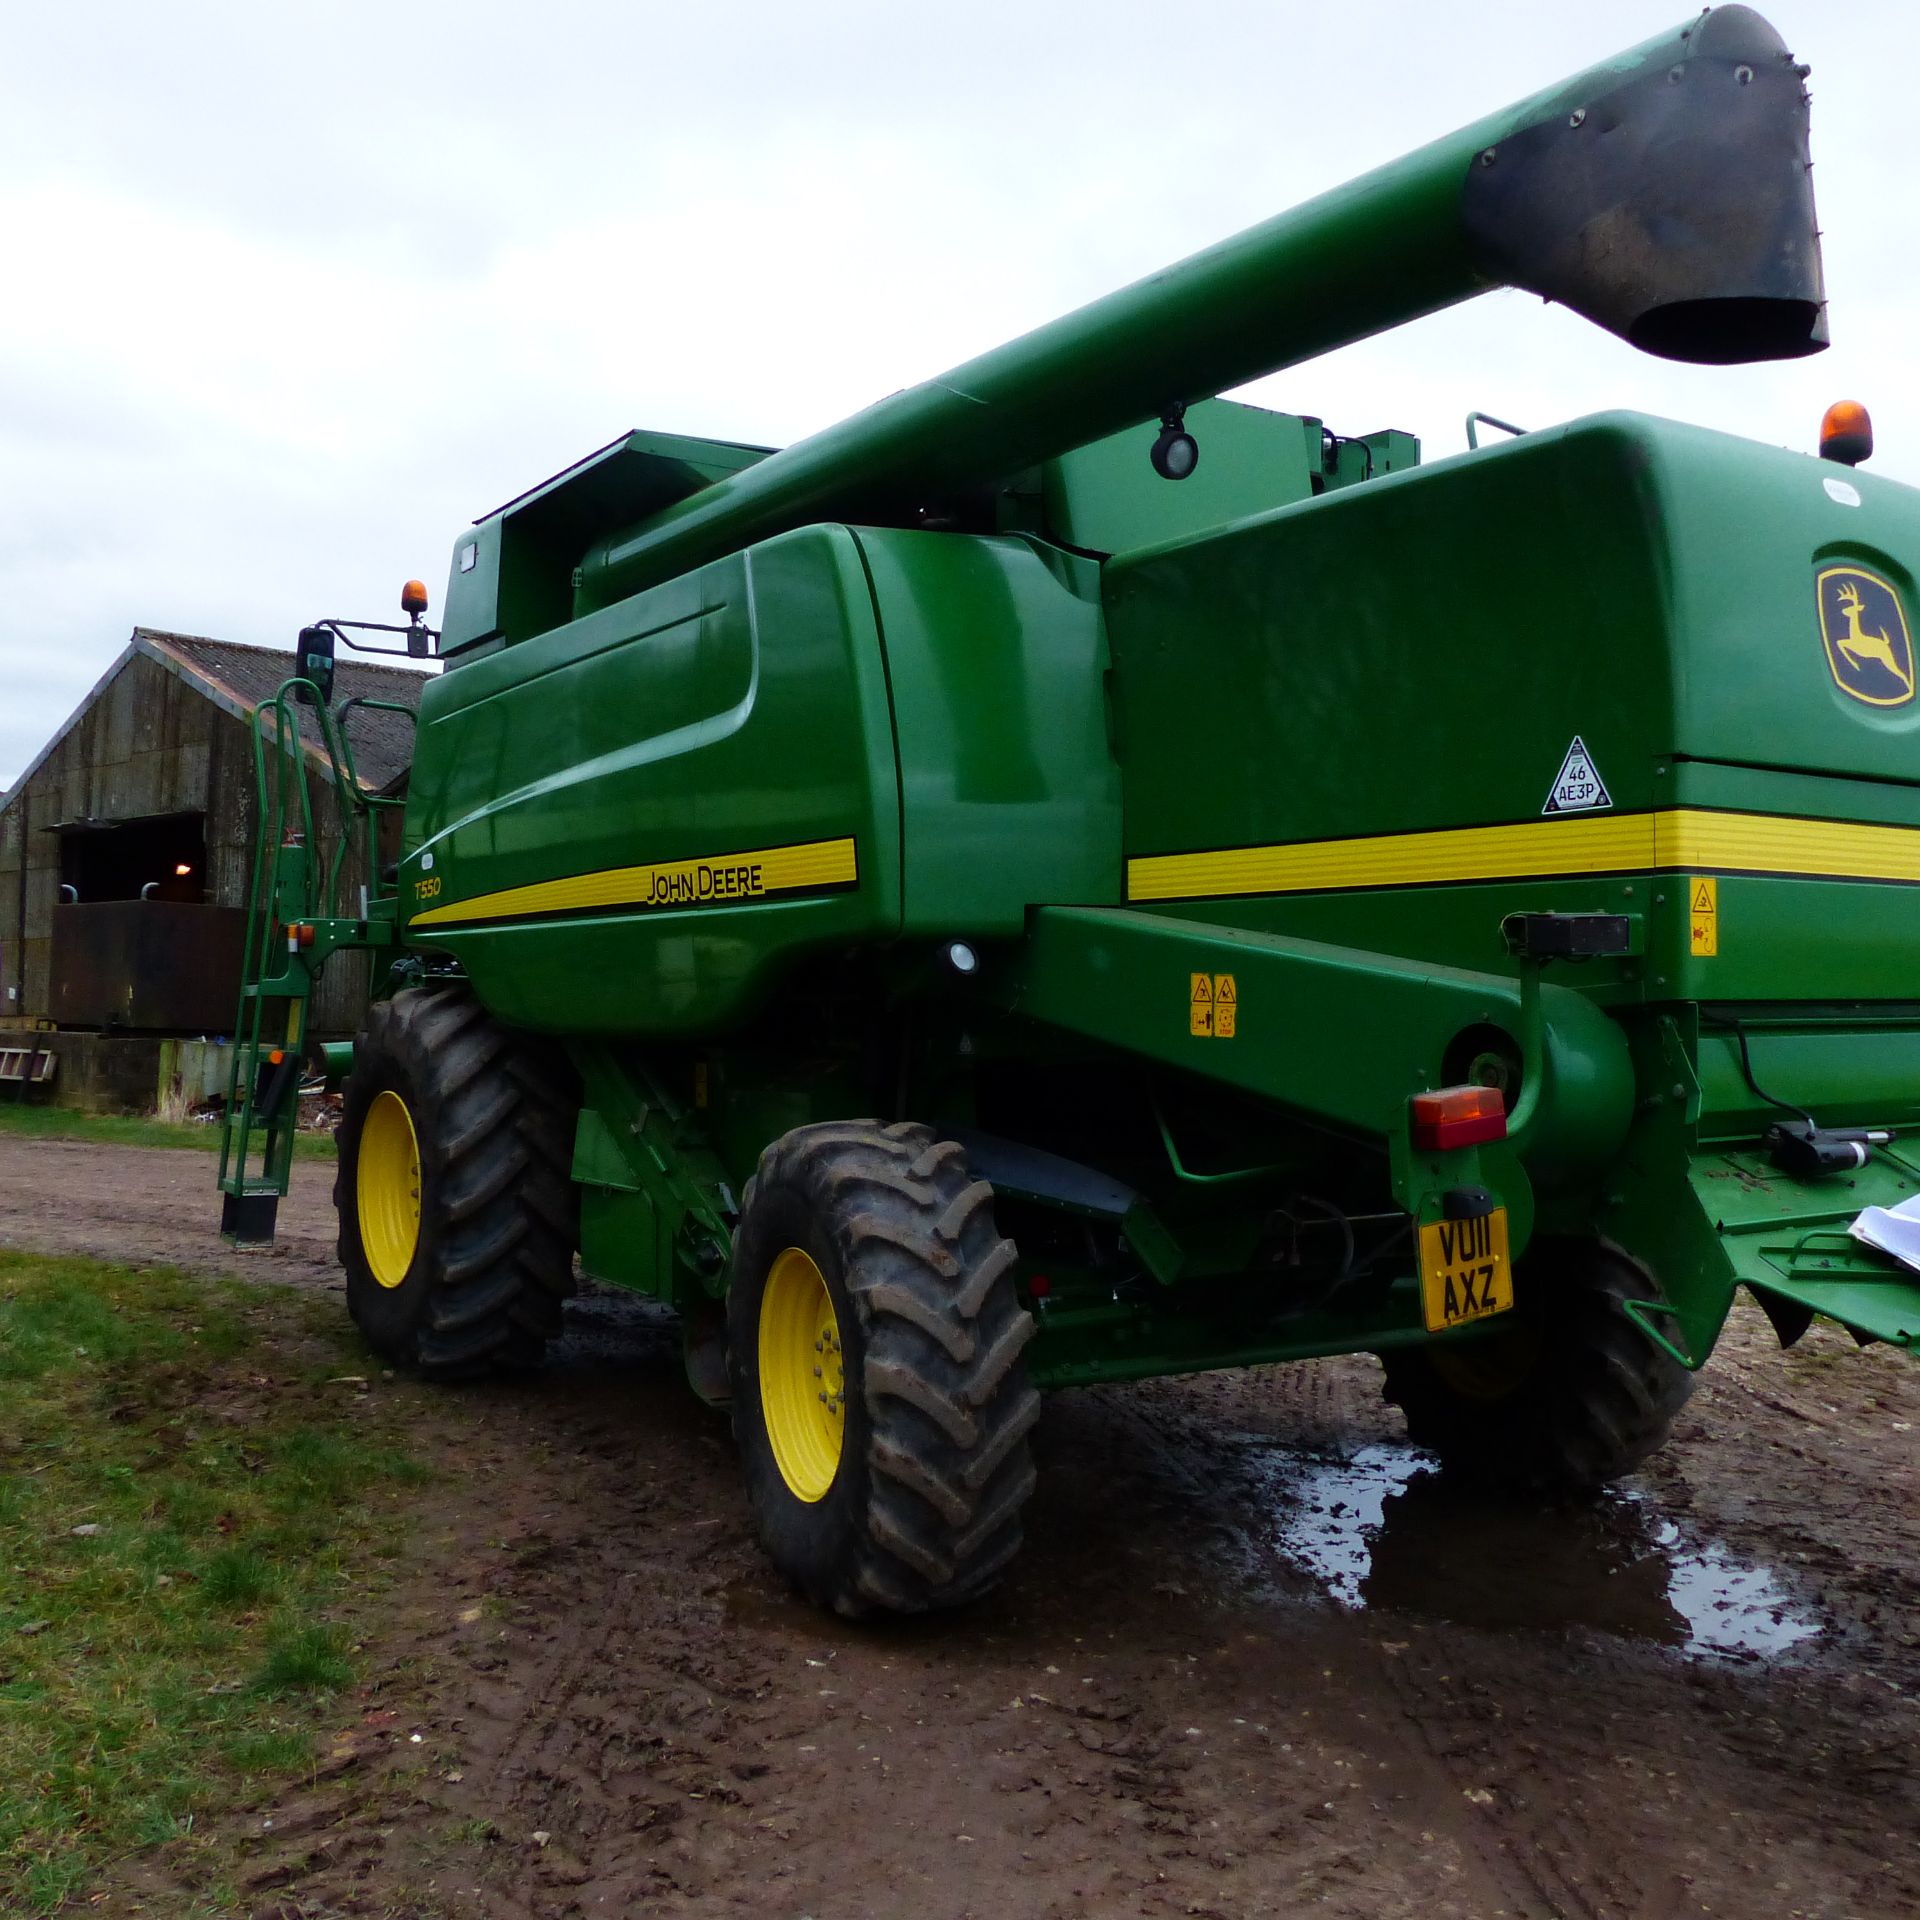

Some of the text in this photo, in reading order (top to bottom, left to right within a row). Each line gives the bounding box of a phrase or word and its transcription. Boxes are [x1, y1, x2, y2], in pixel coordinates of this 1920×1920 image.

[1569, 765, 1586, 781] 46
[1559, 783, 1594, 801] AE3P
[415, 877, 441, 900] T550
[647, 865, 763, 901] JOHN DEERE
[1444, 1264, 1497, 1319] AXZ
